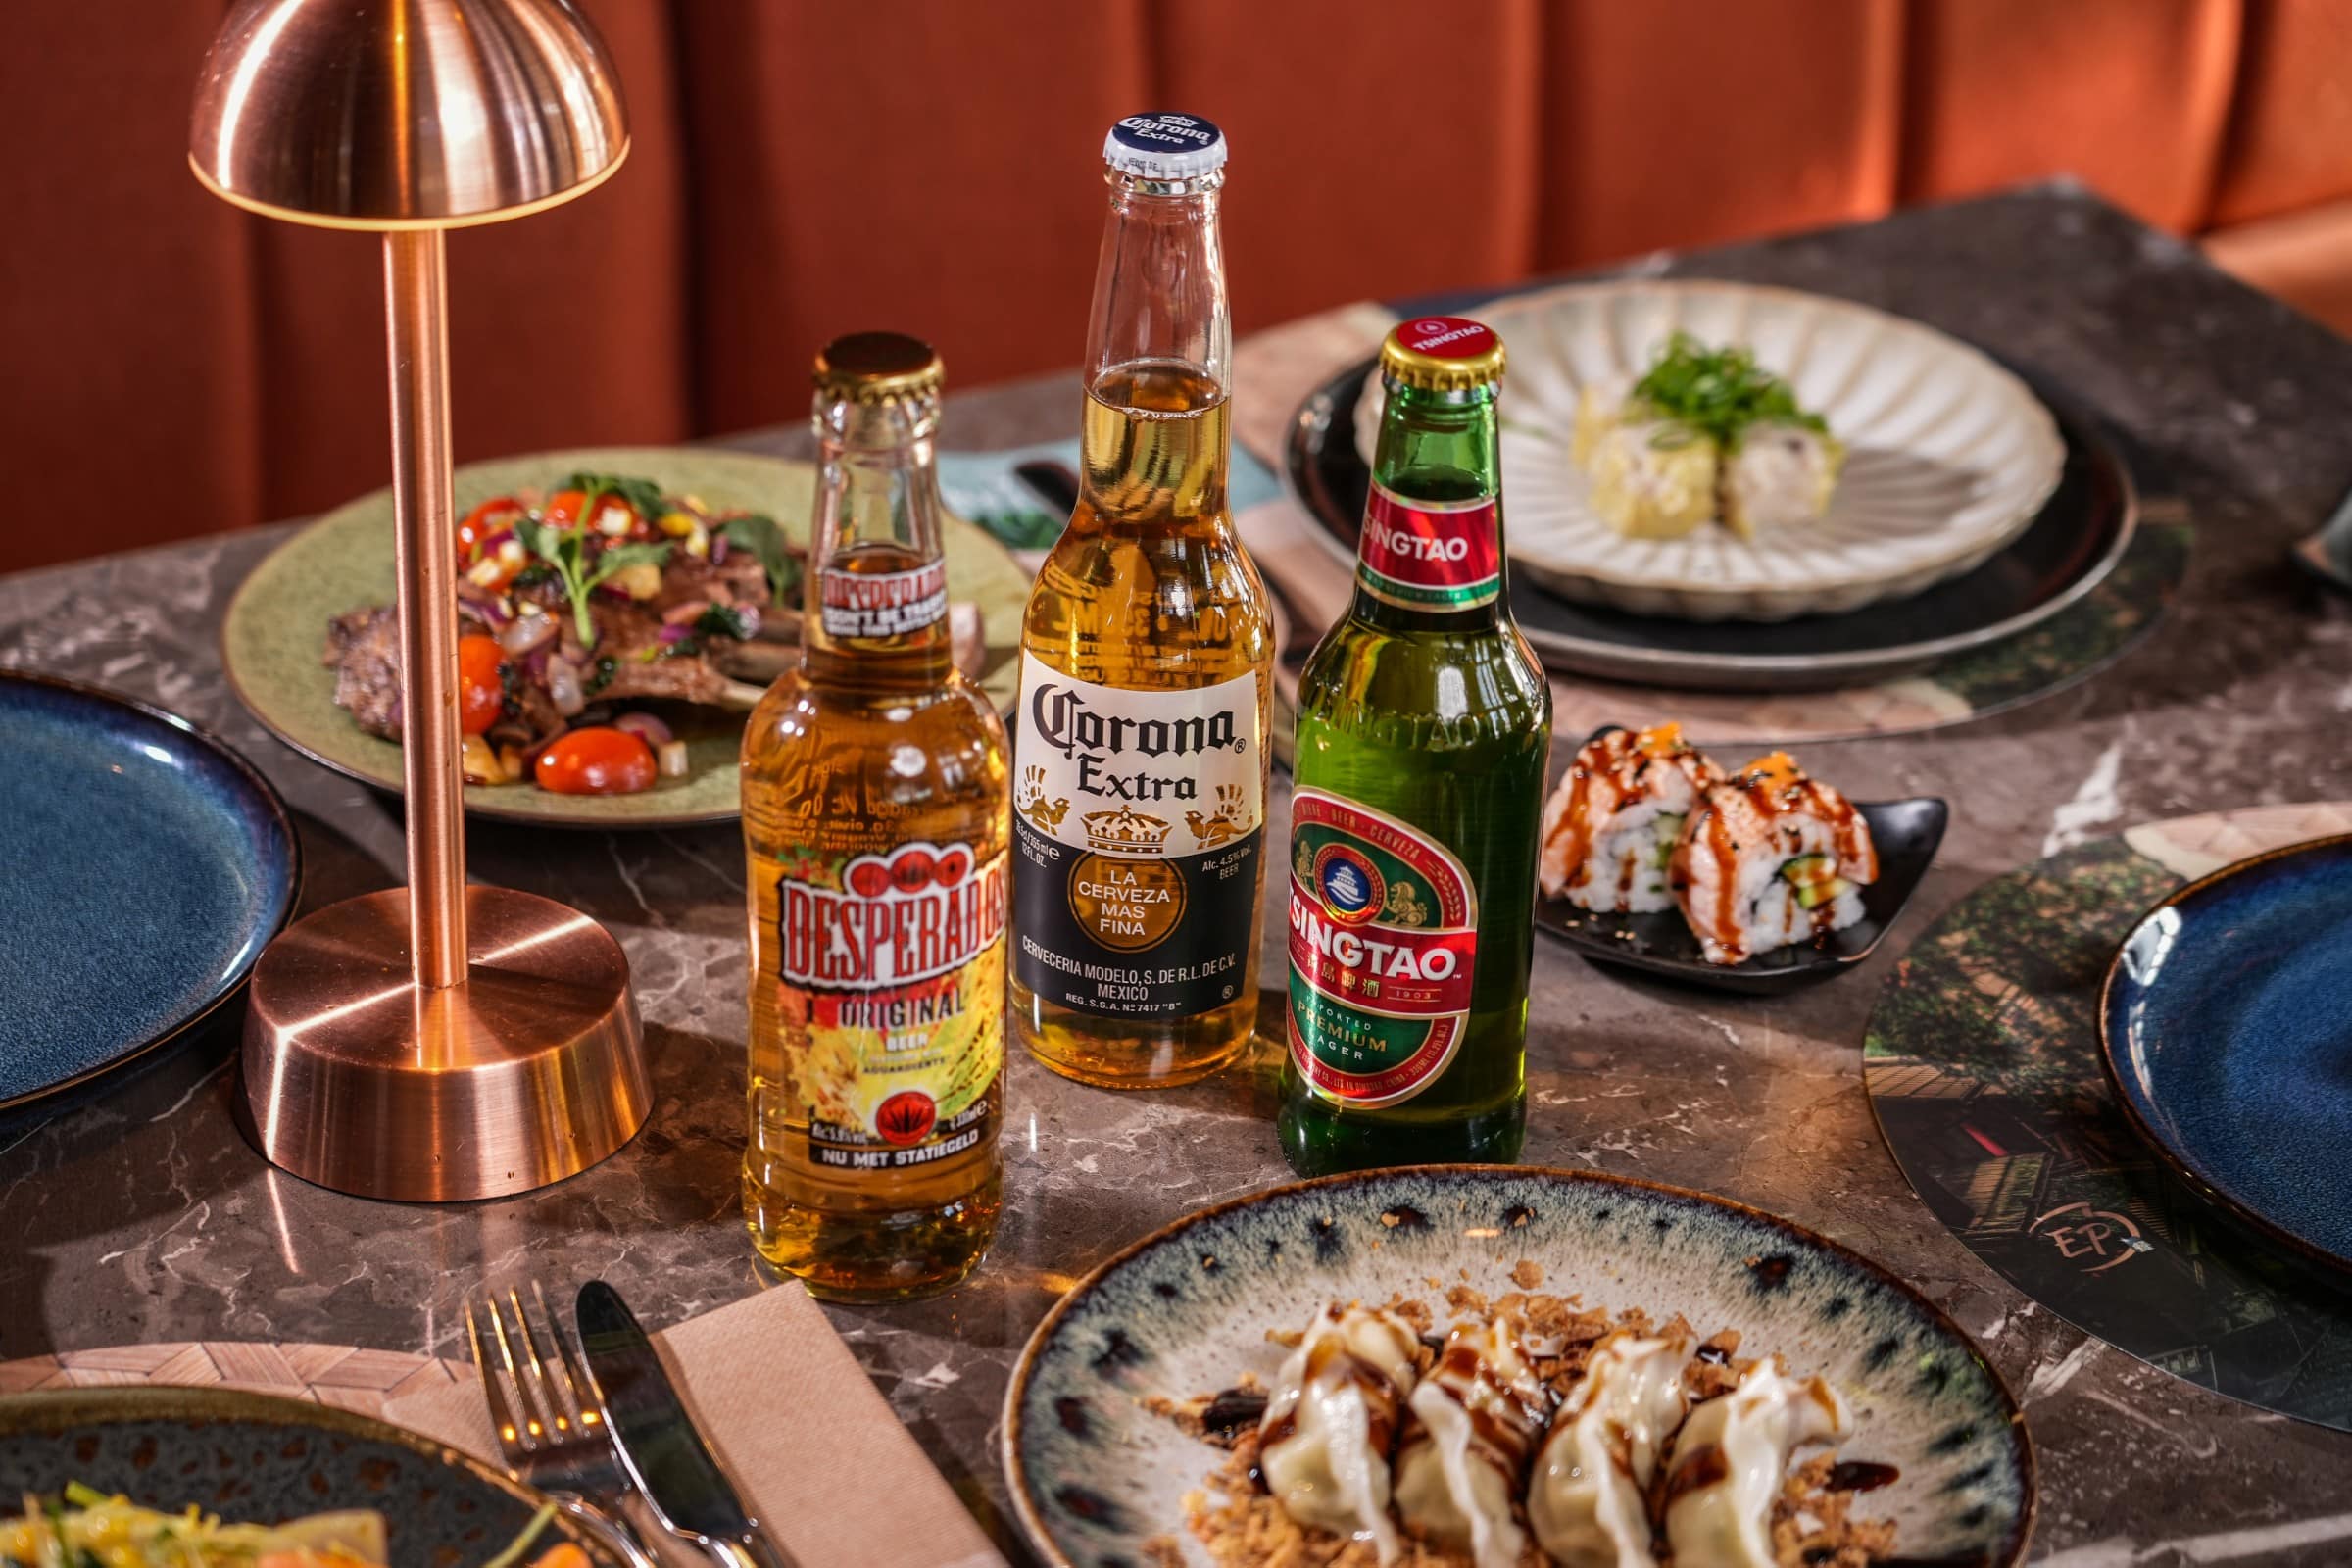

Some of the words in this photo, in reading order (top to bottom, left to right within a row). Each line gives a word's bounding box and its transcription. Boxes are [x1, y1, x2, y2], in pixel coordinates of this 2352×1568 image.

[1118, 117, 1211, 142] Corona
[1135, 128, 1185, 145] Extra
[1412, 325, 1486, 351] TSINGTAO
[1033, 683, 1237, 760] Corona
[1077, 752, 1198, 801] Extra
[1370, 823, 1420, 861] CERVEZA
[1109, 869, 1137, 886] LA
[1220, 862, 1240, 880] BEER
[1078, 880, 1170, 904] CERVEZA
[1102, 902, 1146, 919] MAS
[1100, 918, 1146, 936] FINA
[1022, 934, 1082, 976] CERVECERIA
[1144, 969, 1156, 986] S.
[1159, 968, 1175, 985] DE
[1178, 964, 1202, 983] R.L.
[1202, 958, 1217, 978] DE
[1218, 952, 1237, 973] C.V.
[1065, 992, 1089, 1007] REG.
[1089, 999, 1120, 1012] S.S.A.
[1137, 1004, 1160, 1013] 7417
[1097, 983, 1149, 1002] MEXICO
[1396, 990, 1432, 1000] 1903
[839, 986, 965, 1030] ORIGINAL
[1297, 1000, 1388, 1053] PREMIUM
[887, 1033, 928, 1052] BEER
[1311, 1034, 1363, 1060] AGER
[822, 1148, 848, 1165] NU
[853, 1151, 890, 1167] MET
[894, 1128, 979, 1166] STATIEGELD
